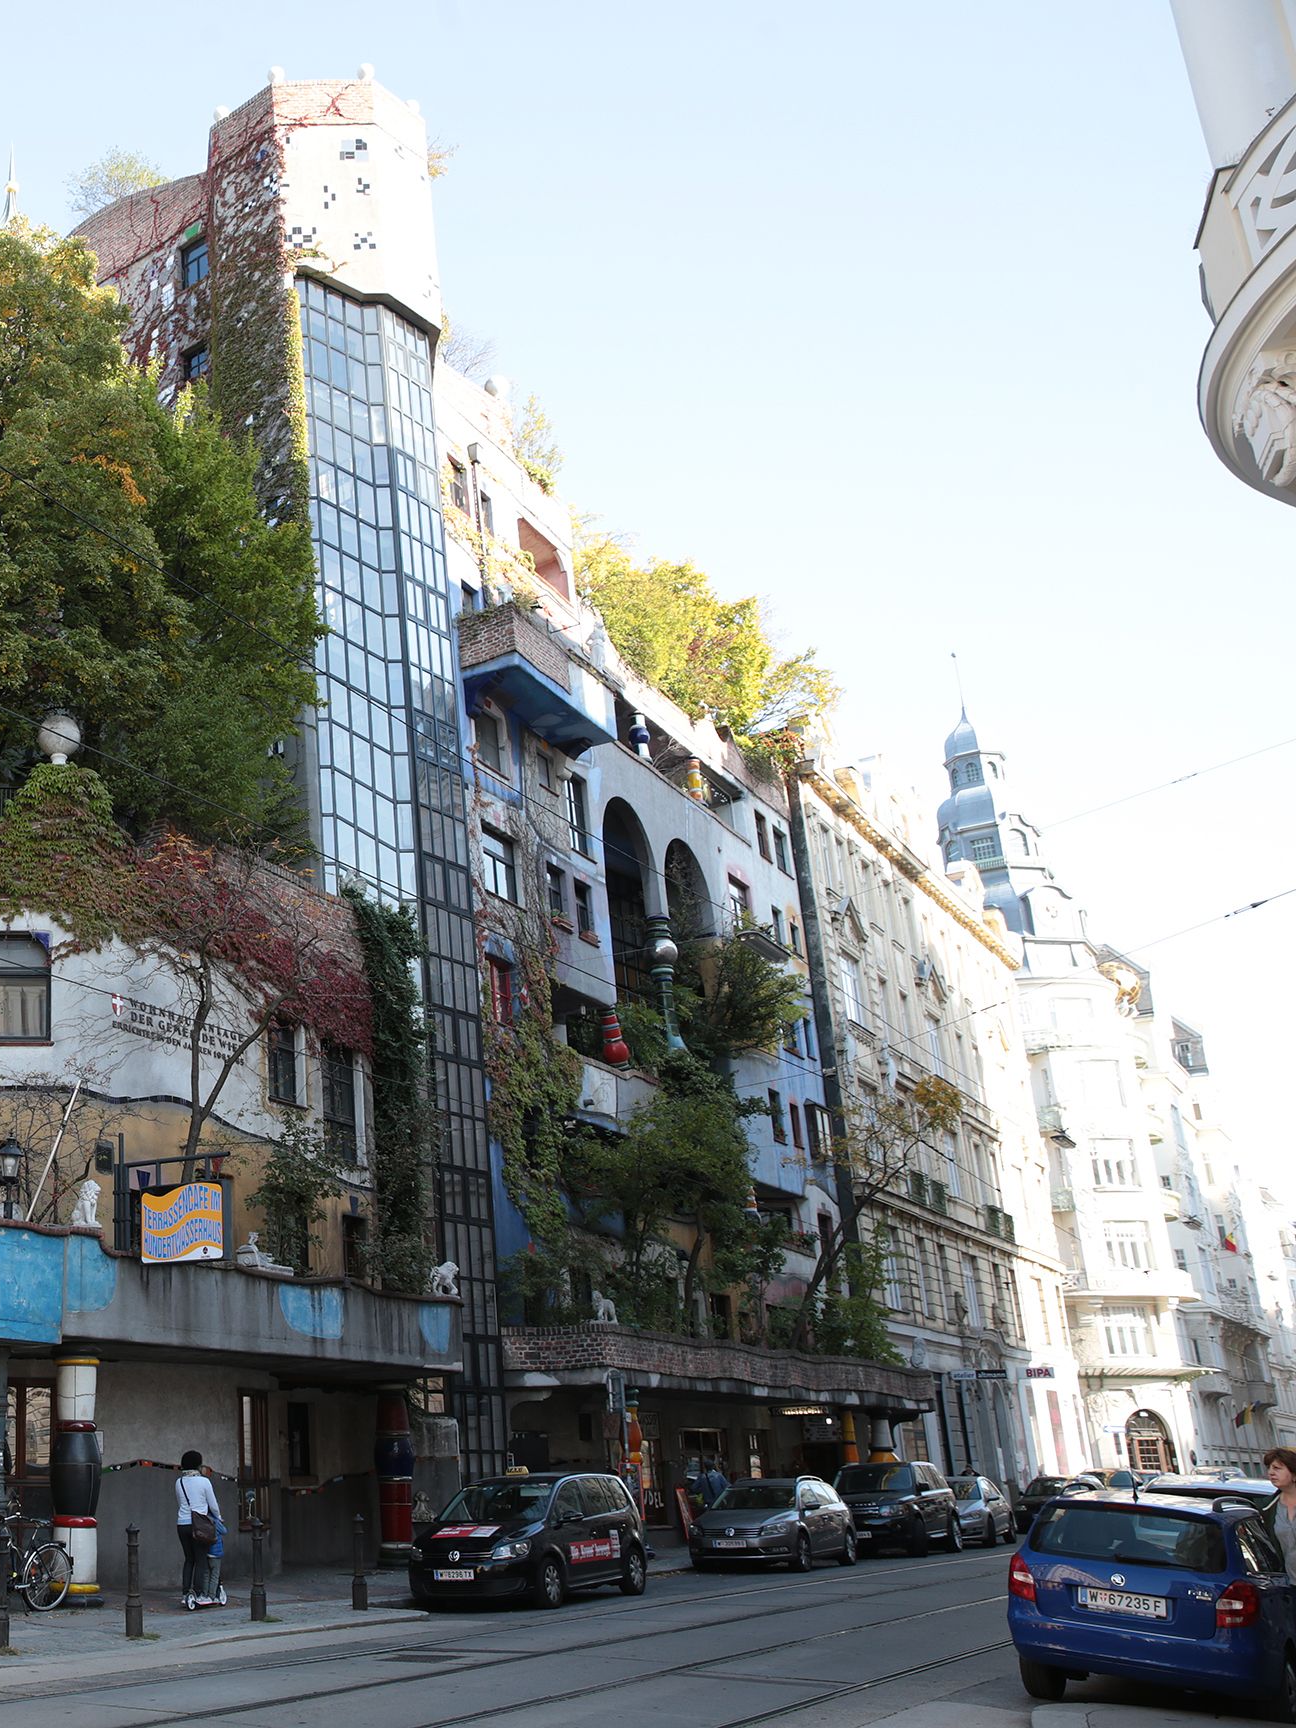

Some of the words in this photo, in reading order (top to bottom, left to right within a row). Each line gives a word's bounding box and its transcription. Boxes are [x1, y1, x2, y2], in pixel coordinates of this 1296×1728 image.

[128, 998, 244, 1043] WOHNHAUANLAGE
[130, 1011, 154, 1027] DER
[183, 1042, 212, 1056] JAREN
[144, 1185, 208, 1230] TERRASSENCAFE
[144, 1218, 221, 1258] HUNDERTWASSERHAUS
[953, 1371, 975, 1379] atelier
[1025, 1368, 1051, 1378] BIPA
[1089, 1590, 1098, 1602] W
[1108, 1593, 1150, 1611] 67235
[1153, 1600, 1161, 1612] F
